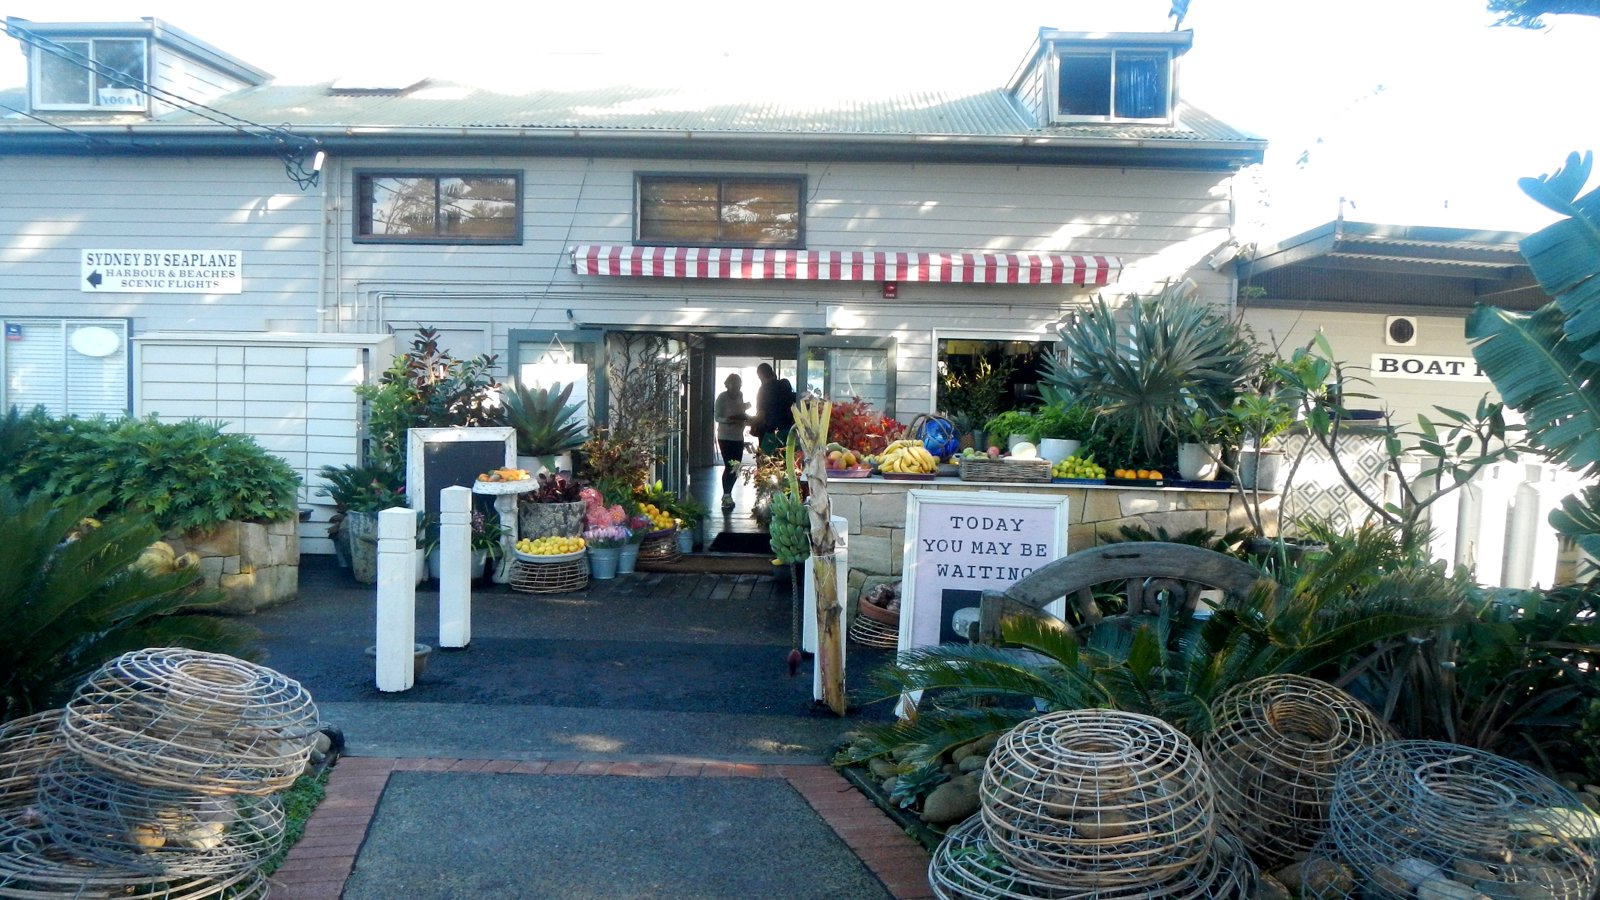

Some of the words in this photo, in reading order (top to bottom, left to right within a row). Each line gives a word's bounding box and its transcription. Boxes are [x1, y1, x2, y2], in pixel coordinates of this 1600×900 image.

[102, 96, 133, 105] YOGA
[87, 253, 141, 266] SYDNEY
[144, 253, 161, 266] BY
[164, 254, 237, 267] SEAPLANE
[106, 269, 166, 278] HARBOUR
[168, 270, 176, 278] &
[179, 270, 236, 279] BEACHES
[121, 279, 165, 288] SCENIC
[168, 280, 219, 288] FLIGHTS
[1379, 358, 1465, 376] BOAT
[950, 516, 1024, 532] TODAY
[923, 539, 963, 553] YOU
[971, 541, 1013, 556] MAY
[1020, 543, 1047, 557] BE
